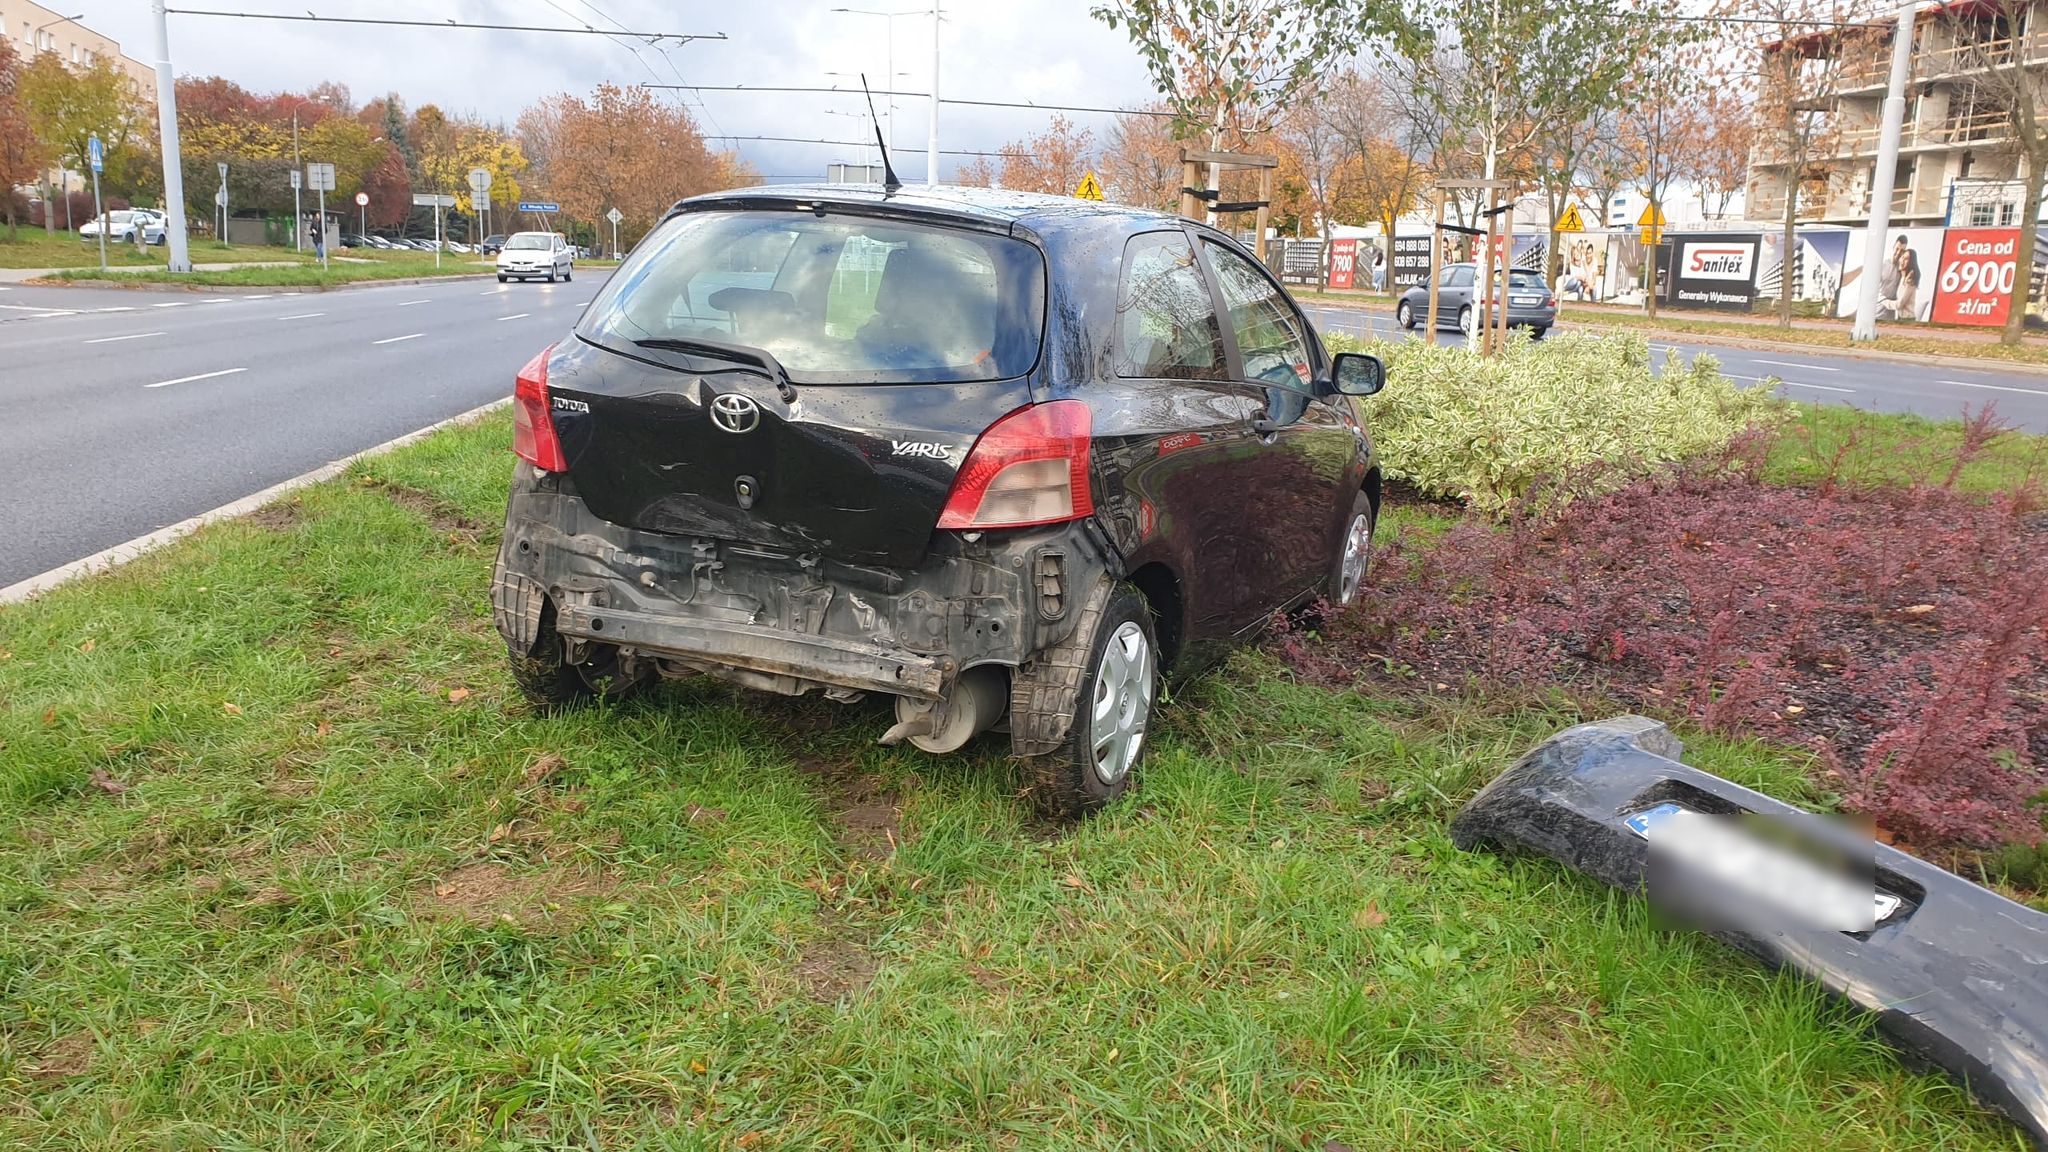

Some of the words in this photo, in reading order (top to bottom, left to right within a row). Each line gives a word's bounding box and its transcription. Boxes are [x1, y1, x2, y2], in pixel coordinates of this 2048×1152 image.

[1957, 239, 1991, 255] Cena
[1994, 238, 2014, 254] od
[1332, 254, 1352, 272] 7900
[1406, 256, 1416, 267] 657
[1417, 256, 1429, 267] 288
[1690, 249, 1744, 273] Sanitex
[1941, 261, 2017, 294] 6900
[1679, 290, 1709, 303] Generalny
[1709, 291, 1748, 304] Wykonawca
[552, 396, 590, 414] TOYOTA
